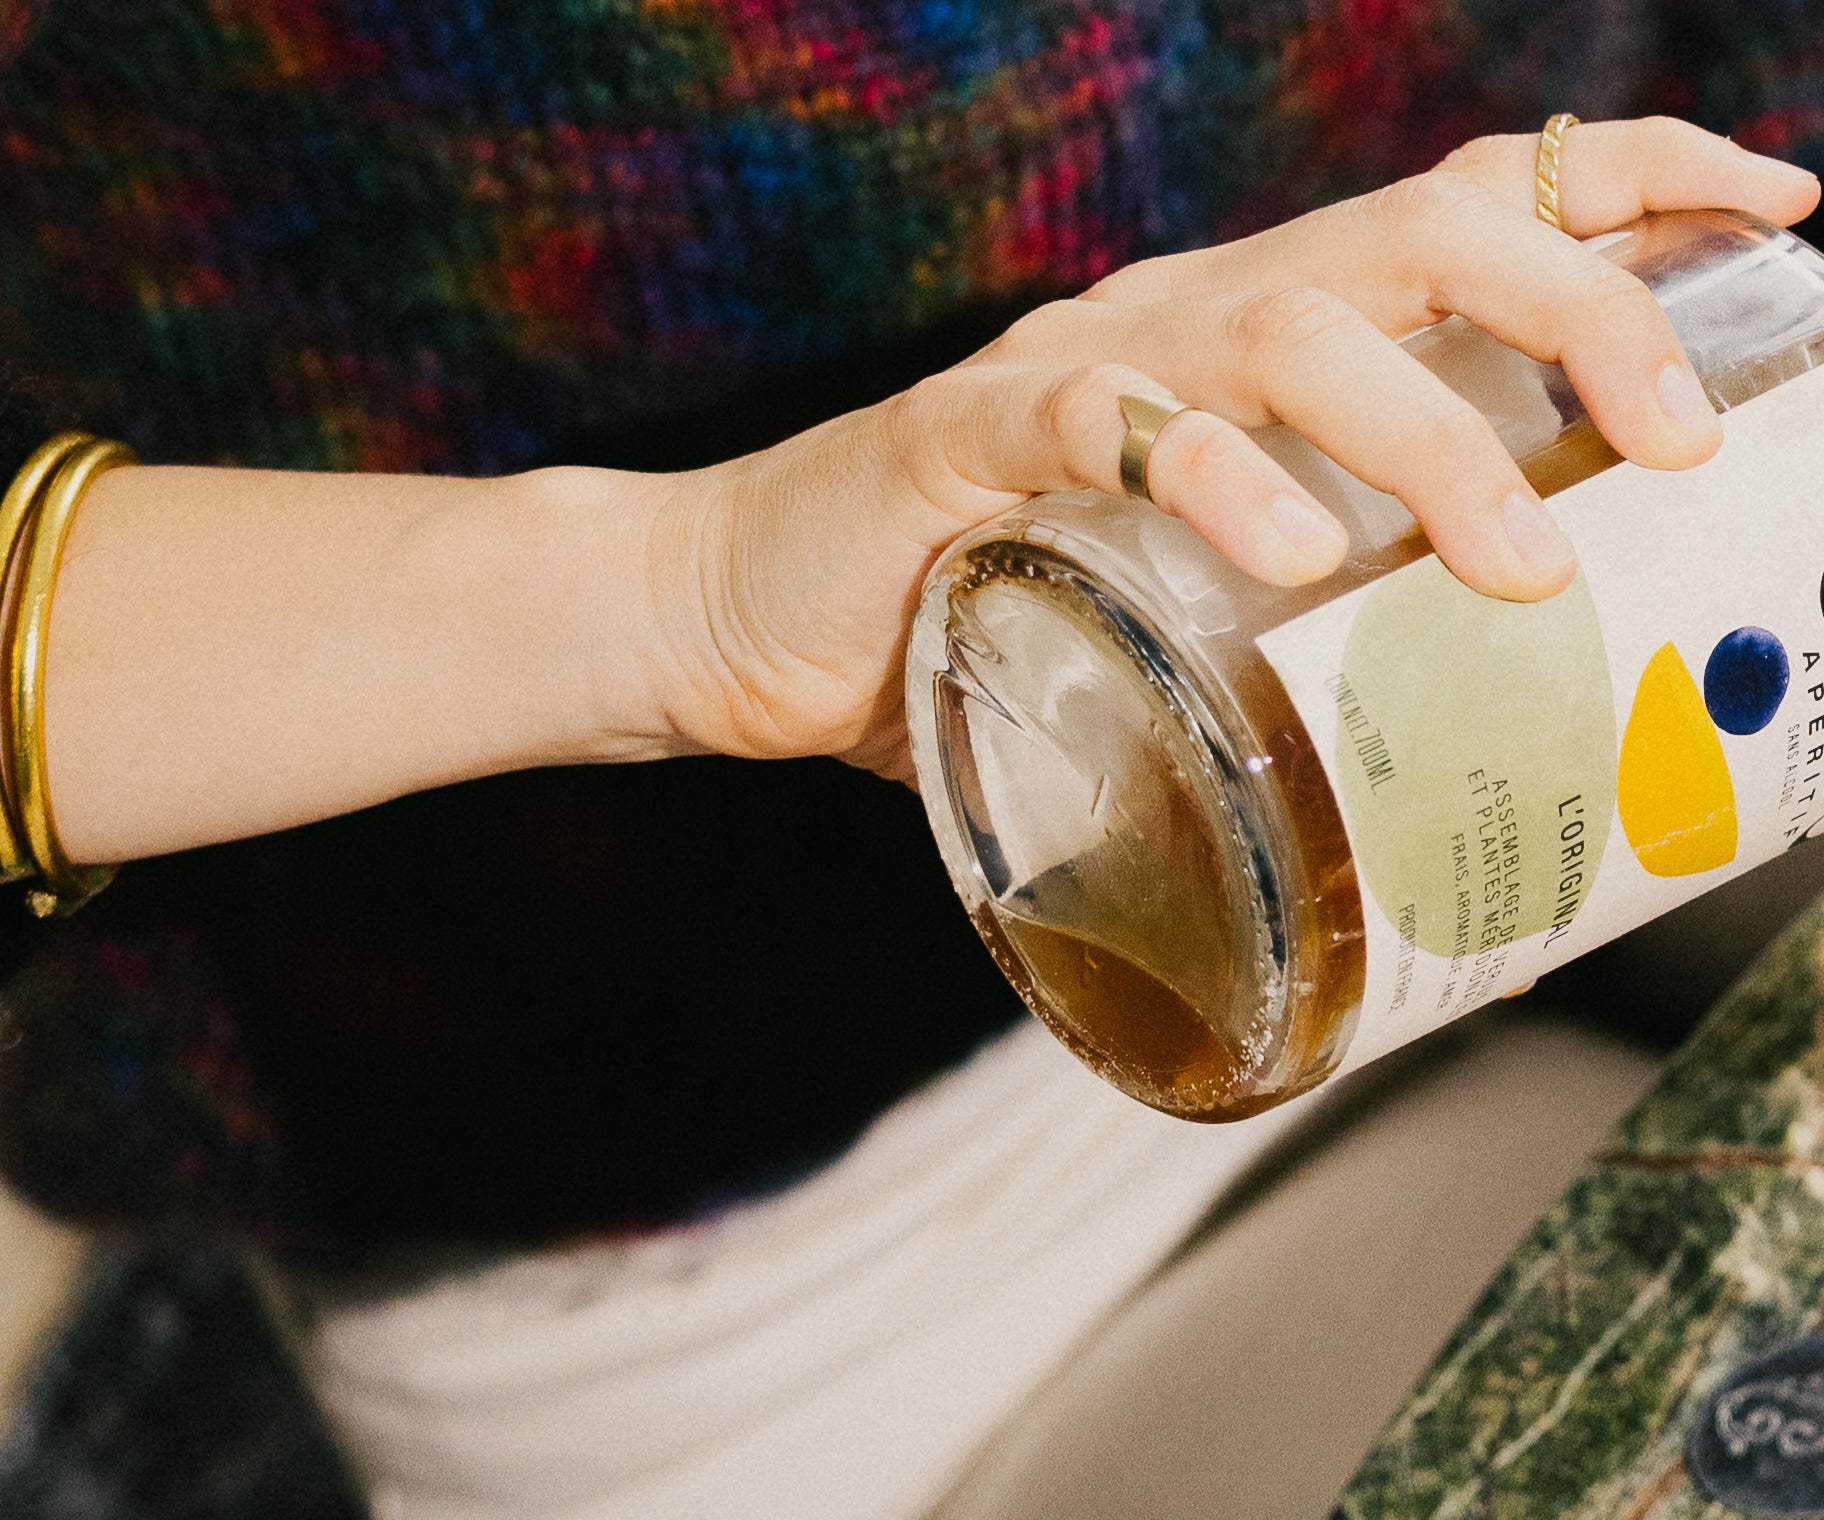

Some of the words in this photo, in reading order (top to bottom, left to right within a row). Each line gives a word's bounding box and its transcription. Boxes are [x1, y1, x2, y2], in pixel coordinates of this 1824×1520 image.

[1786, 723, 1801, 759] SANS
[1467, 768, 1488, 795] ET
[1778, 763, 1798, 812] ALCOOL
[1450, 833, 1470, 888] FRAIS,
[1476, 805, 1501, 904] PLANTES
[1491, 779, 1521, 921] ASSEMBLAGE
[1398, 903, 1416, 956] PRODUIT
[1496, 924, 1516, 949] DE
